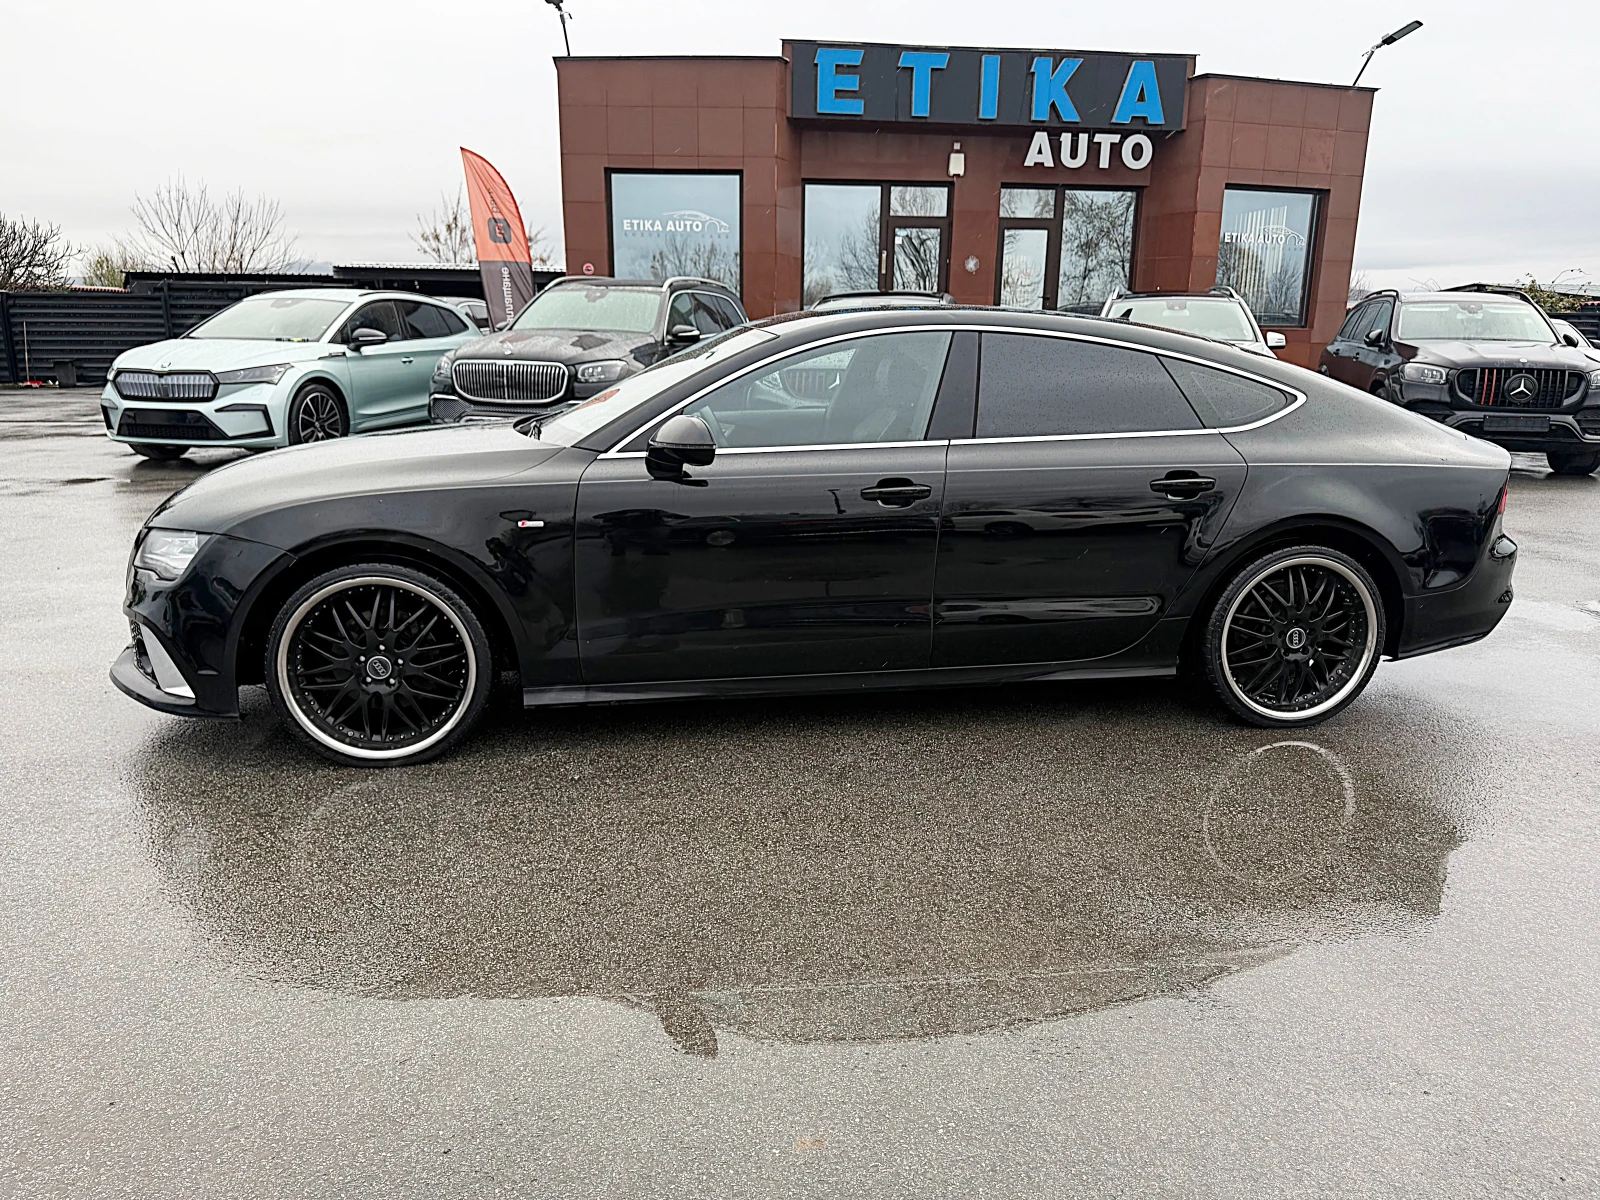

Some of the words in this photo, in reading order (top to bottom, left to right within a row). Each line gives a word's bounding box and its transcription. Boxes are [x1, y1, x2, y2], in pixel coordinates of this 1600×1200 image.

[814, 47, 1165, 126] ETIKA
[1023, 131, 1154, 170] AUTO
[623, 219, 662, 231] ETIKA
[666, 220, 702, 232] AUTO
[1224, 231, 1254, 243] ETIKA
[1257, 233, 1285, 245] AUTO
